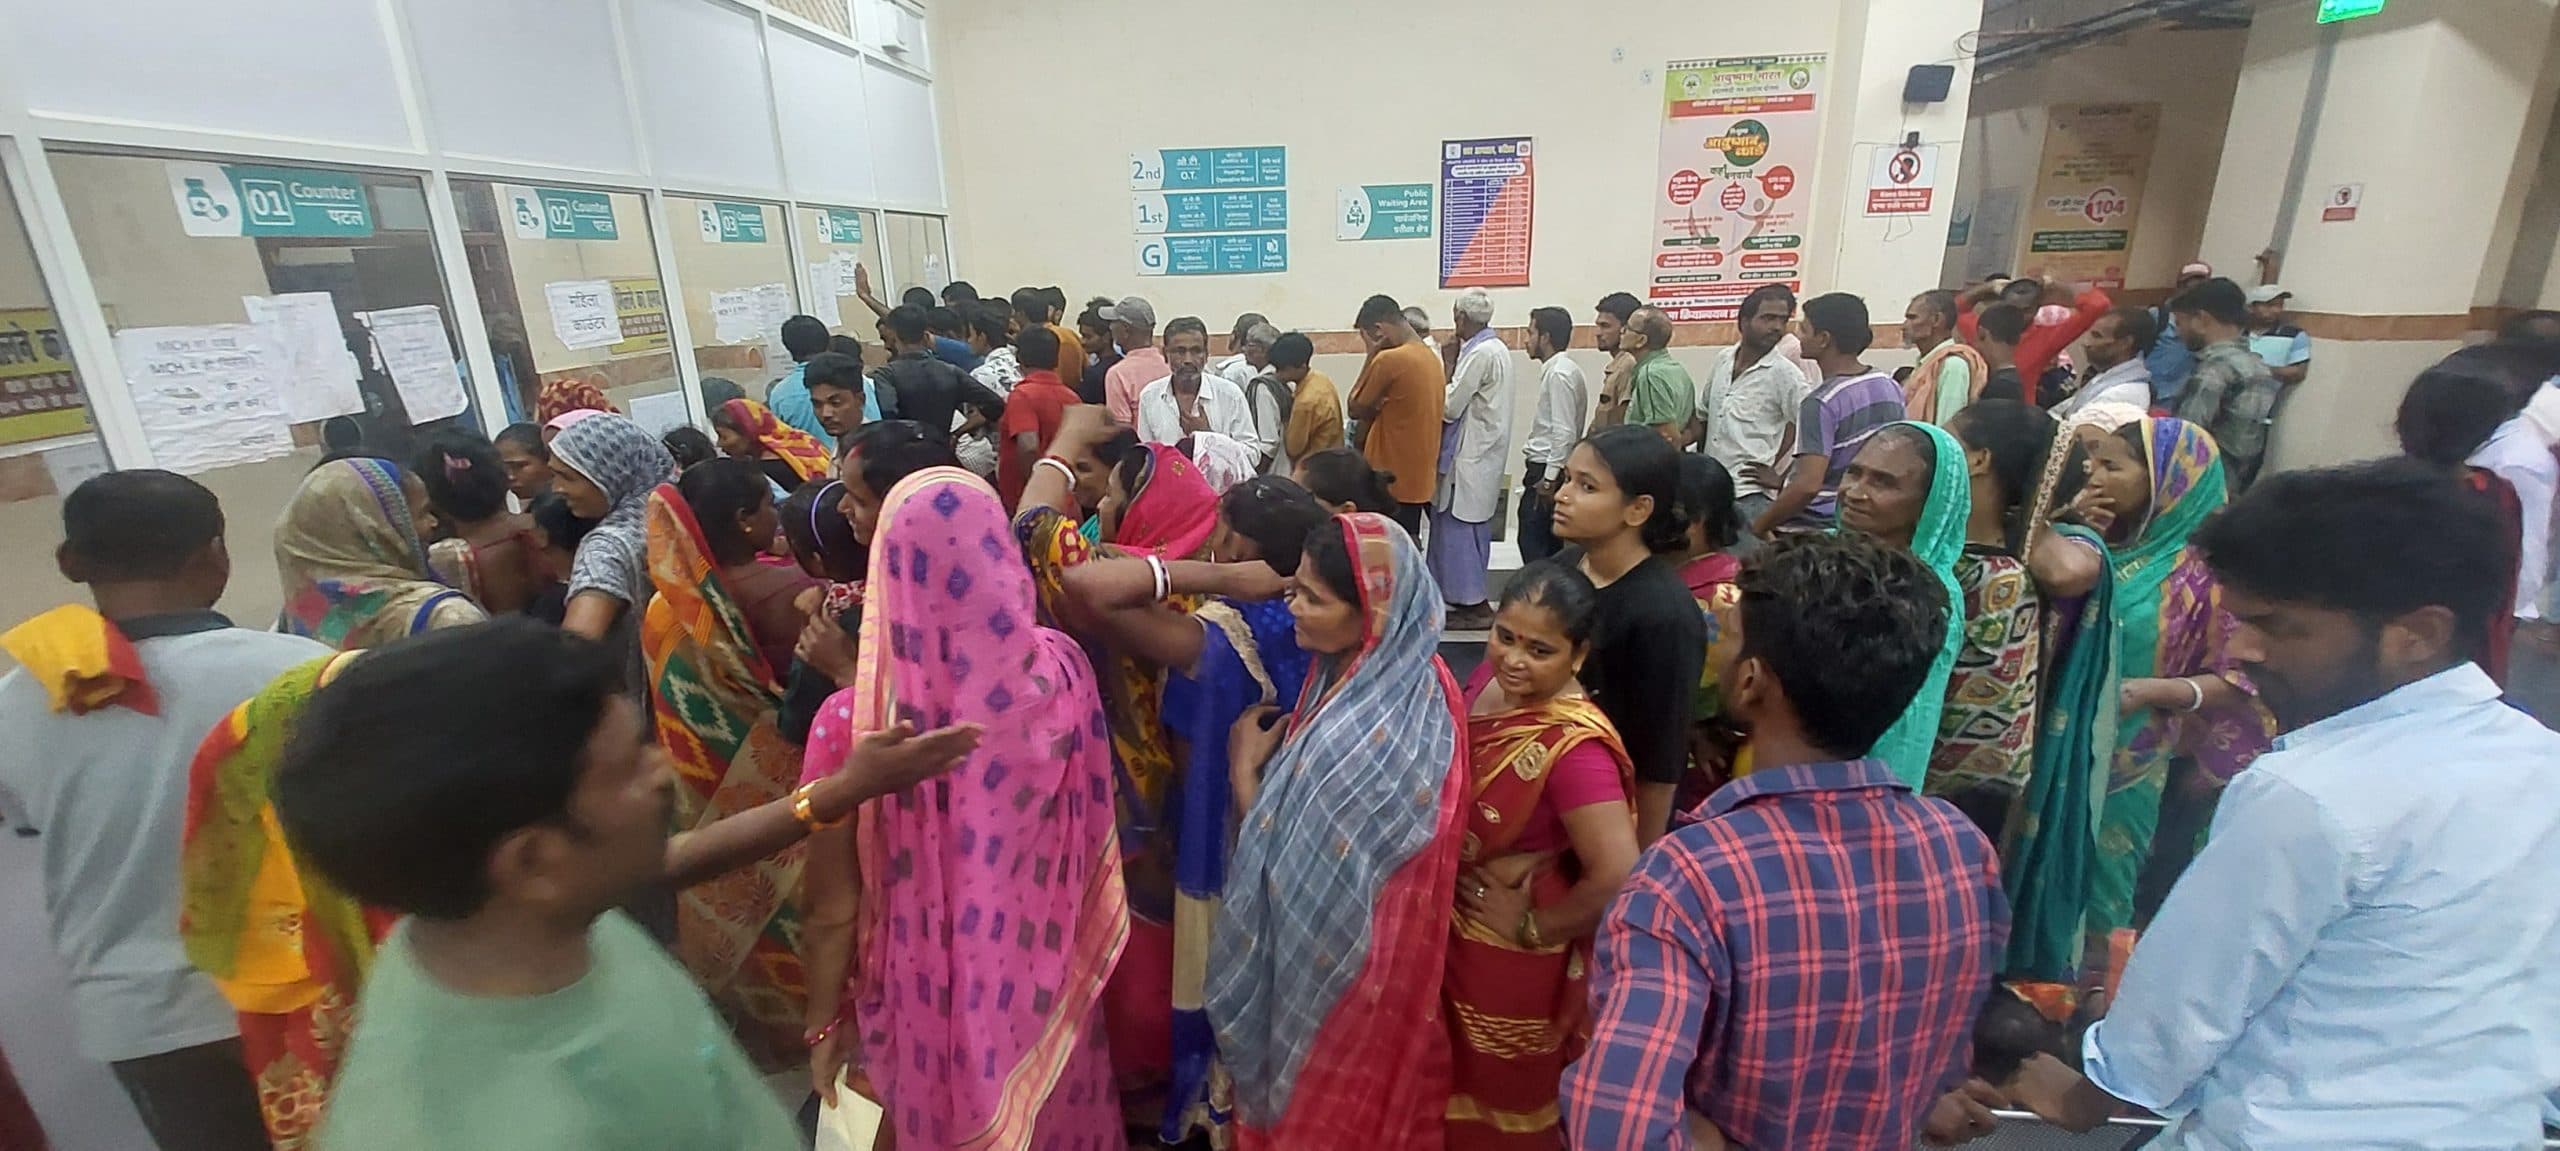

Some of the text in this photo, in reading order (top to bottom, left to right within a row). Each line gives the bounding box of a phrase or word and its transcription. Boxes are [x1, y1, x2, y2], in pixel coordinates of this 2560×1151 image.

[1132, 160, 1161, 180] 2nd
[289, 181, 356, 200] Counter
[1403, 189, 1429, 198] Public
[249, 188, 289, 216] 01
[1377, 198, 1429, 208] Waiting Area
[2095, 200, 2125, 215] 104
[326, 209, 365, 226] पटल
[551, 206, 572, 225] 02
[723, 215, 736, 231] 03
[1138, 204, 1163, 224] 1st
[1141, 244, 1162, 268] G
